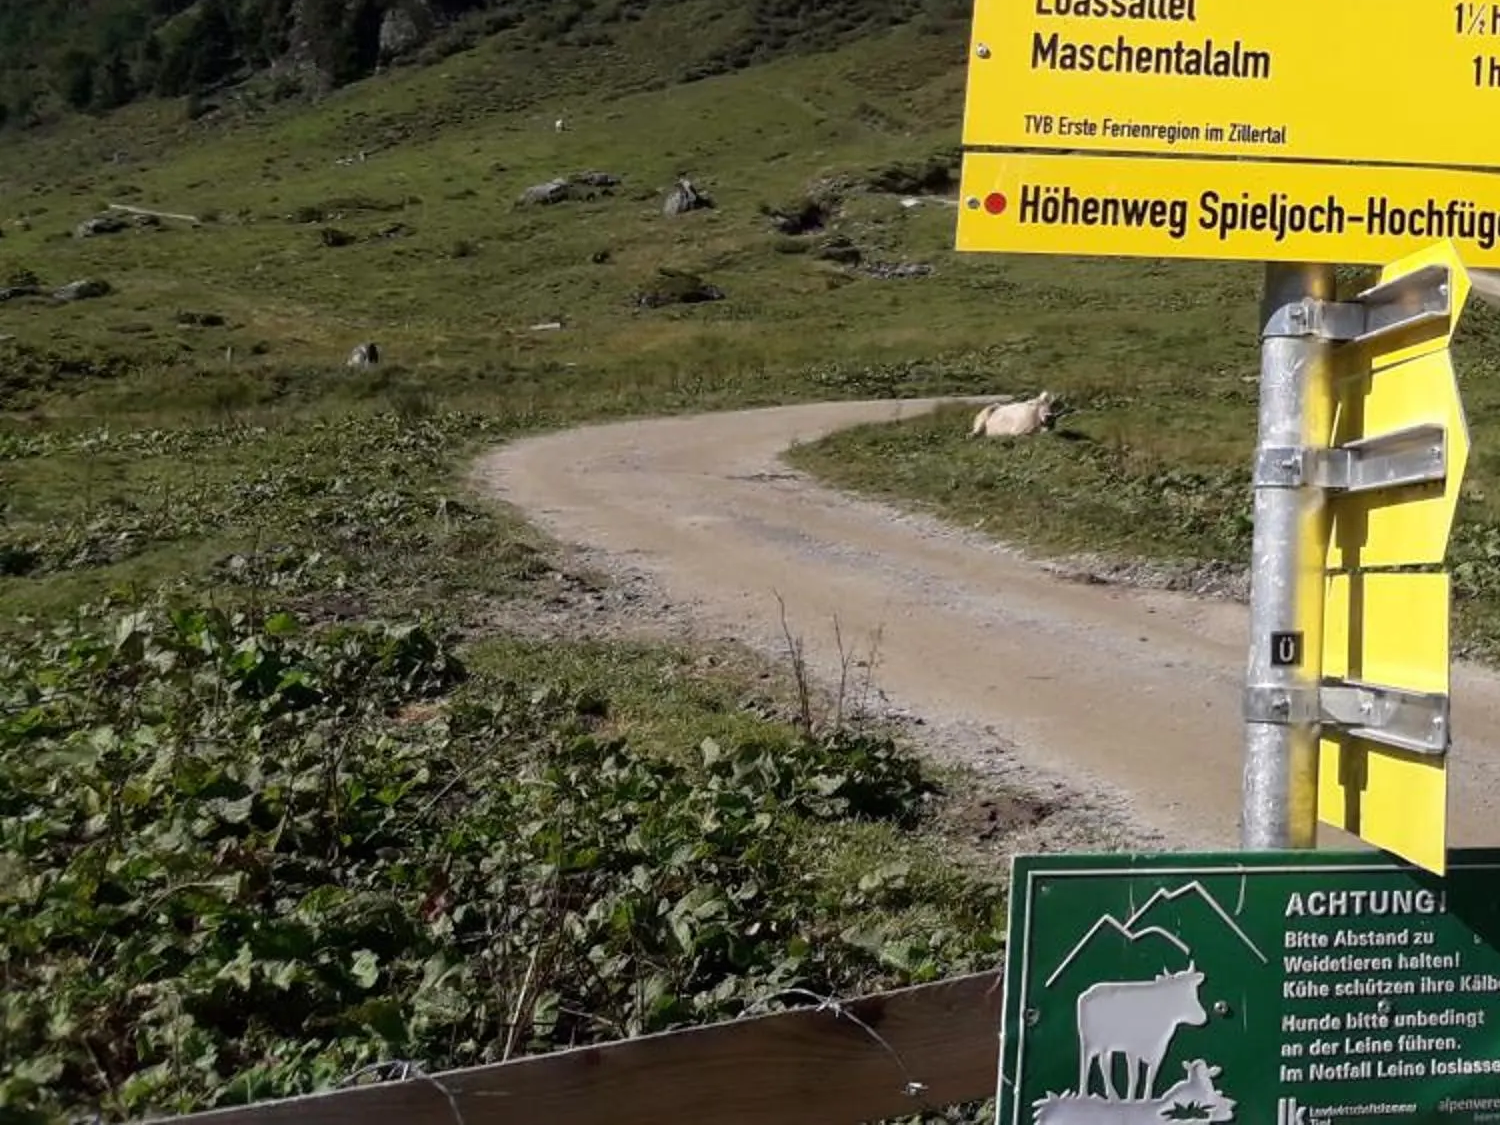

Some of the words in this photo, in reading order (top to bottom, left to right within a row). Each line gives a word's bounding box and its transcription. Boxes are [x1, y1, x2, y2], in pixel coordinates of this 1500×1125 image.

[1031, 33, 1270, 78] Maschentalalm
[1473, 55, 1481, 87] 1
[1025, 115, 1053, 134] TVB
[1059, 117, 1097, 136] Erste
[1103, 119, 1199, 144] Ferienregion
[1205, 123, 1223, 141] im
[1228, 123, 1286, 144] Zillertal
[1019, 185, 1188, 239] Höhenweg
[1285, 889, 1447, 917] ACHTUNG!
[1285, 931, 1328, 948] Bitte
[1334, 929, 1408, 947] Abstand
[1413, 931, 1434, 945] zu
[1284, 954, 1392, 973] Weidetieren
[1398, 952, 1461, 969] halten!
[1283, 980, 1329, 998] Kühe
[1335, 977, 1414, 997] schützen
[1420, 976, 1454, 993] ihre
[1282, 1014, 1341, 1032] Hunde
[1347, 1012, 1388, 1028] bitte
[1395, 1009, 1485, 1028] unbedingt
[1281, 1043, 1303, 1057] an
[1309, 1038, 1338, 1056] der
[1345, 1036, 1393, 1054] Leine
[1398, 1035, 1461, 1052] führen.
[1280, 1065, 1303, 1082] Im
[1309, 1062, 1371, 1081] Notfall
[1377, 1060, 1425, 1078] Leine
